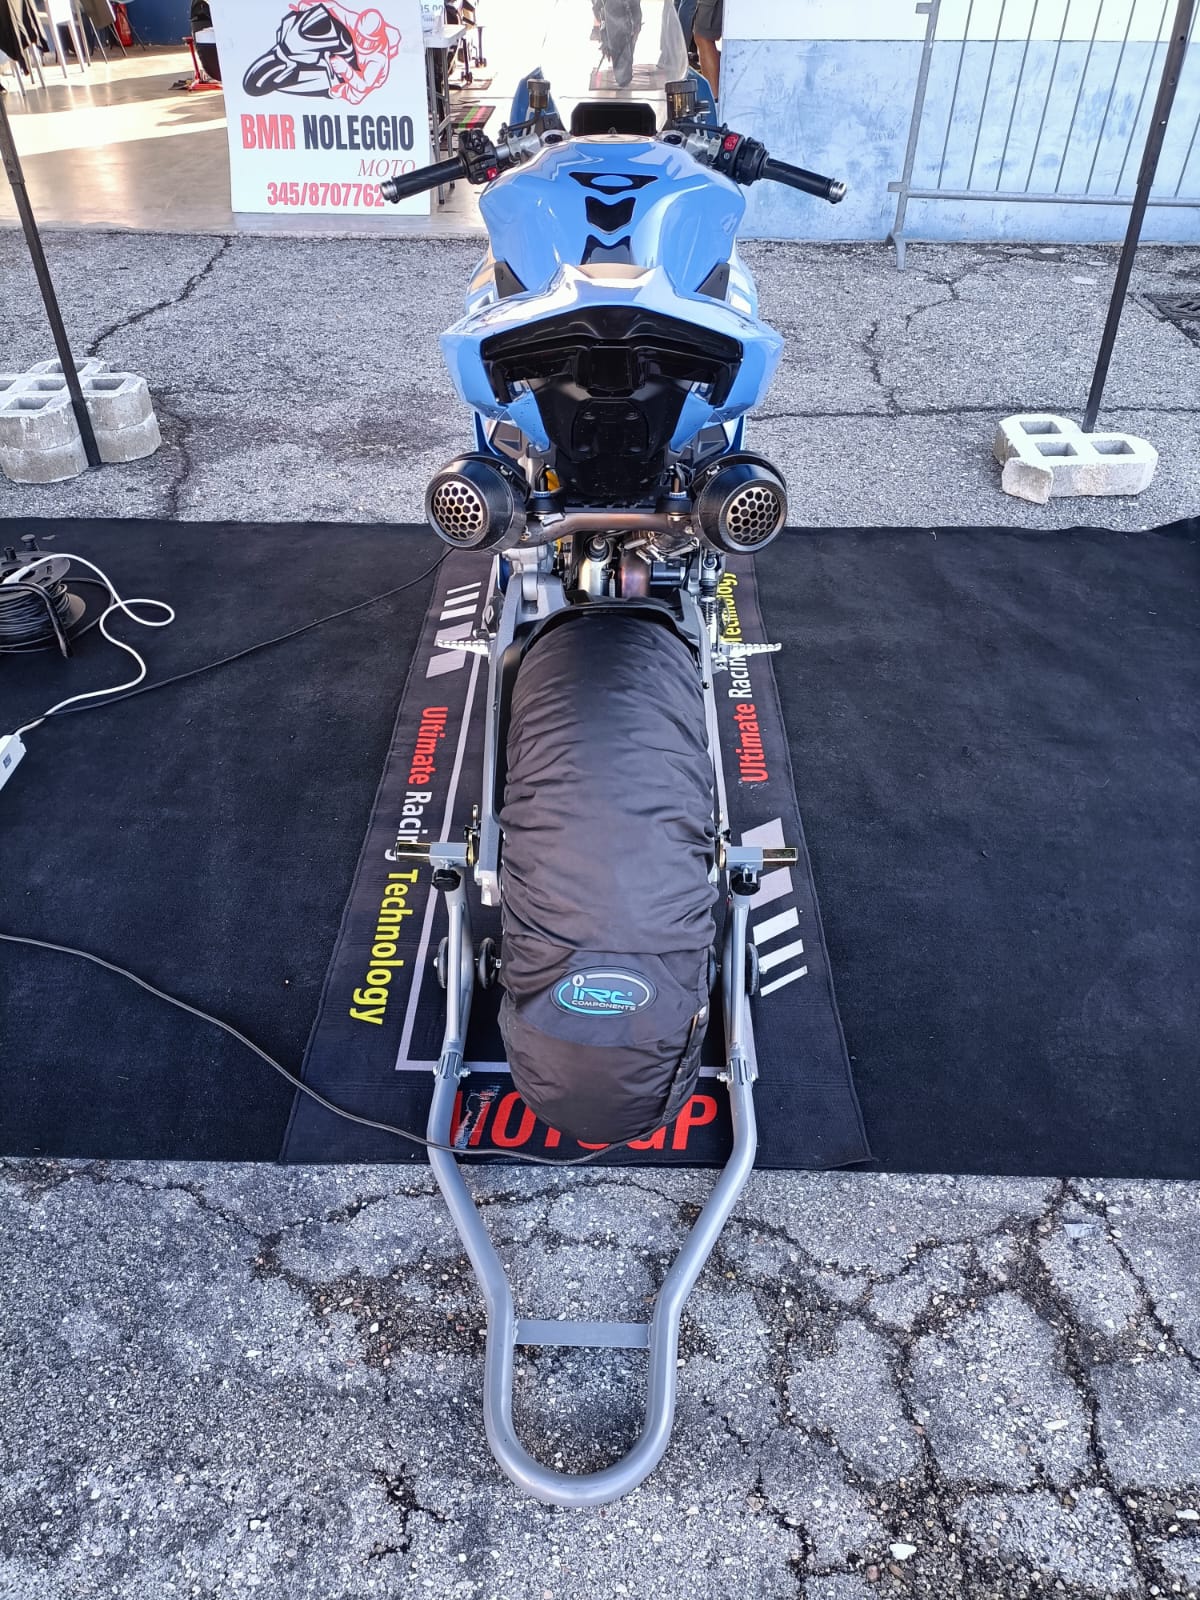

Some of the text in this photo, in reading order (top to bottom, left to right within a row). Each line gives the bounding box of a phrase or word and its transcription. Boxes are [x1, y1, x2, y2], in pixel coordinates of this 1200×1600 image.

[240, 113, 415, 151] BMR NOLEGGIO
[357, 158, 416, 177] MOTO
[267, 182, 385, 207] 345/8707762
[728, 656, 753, 699] Racin
[408, 706, 449, 785] Ultimate
[733, 703, 769, 783] Ultimate
[349, 869, 419, 1025] Technology
[571, 999, 637, 1011] COMPONENTS
